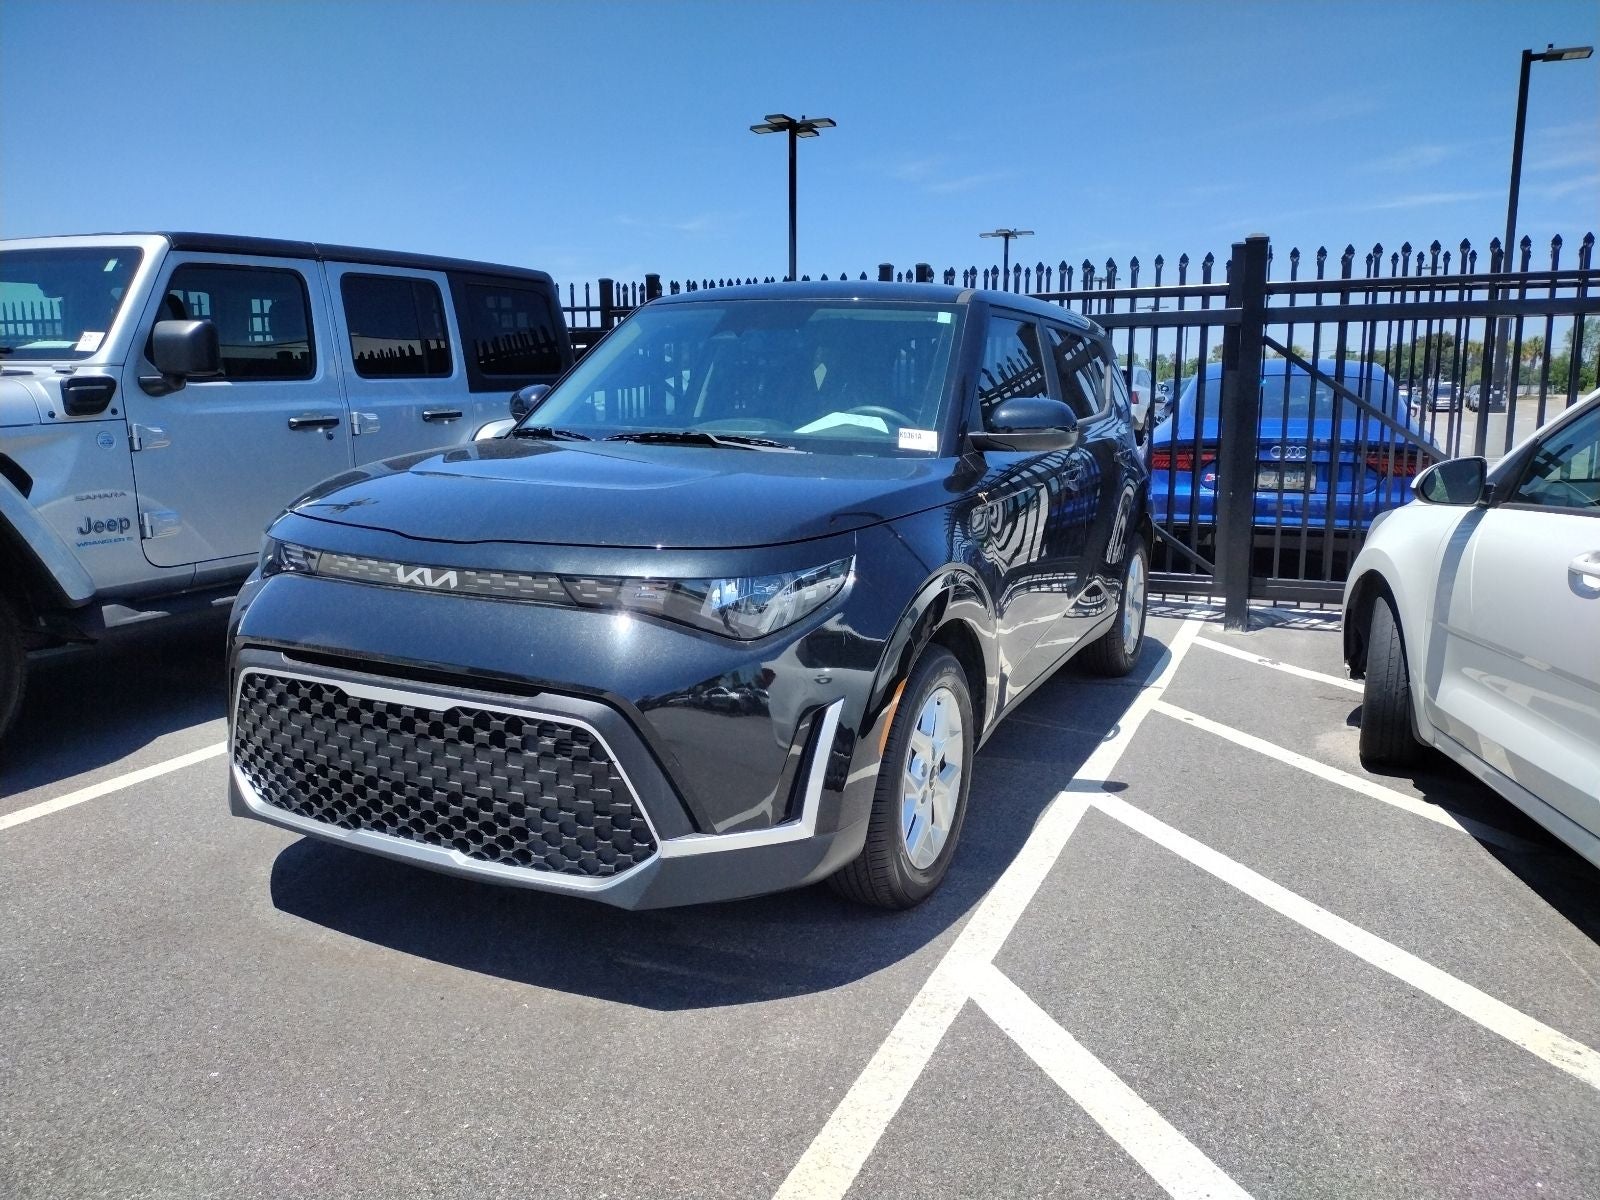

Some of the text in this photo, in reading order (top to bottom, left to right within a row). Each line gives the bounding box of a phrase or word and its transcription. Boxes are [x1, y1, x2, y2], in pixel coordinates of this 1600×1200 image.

[75, 491, 127, 501] SAHARA
[77, 516, 130, 535] Jeep
[397, 565, 457, 589] KIA
